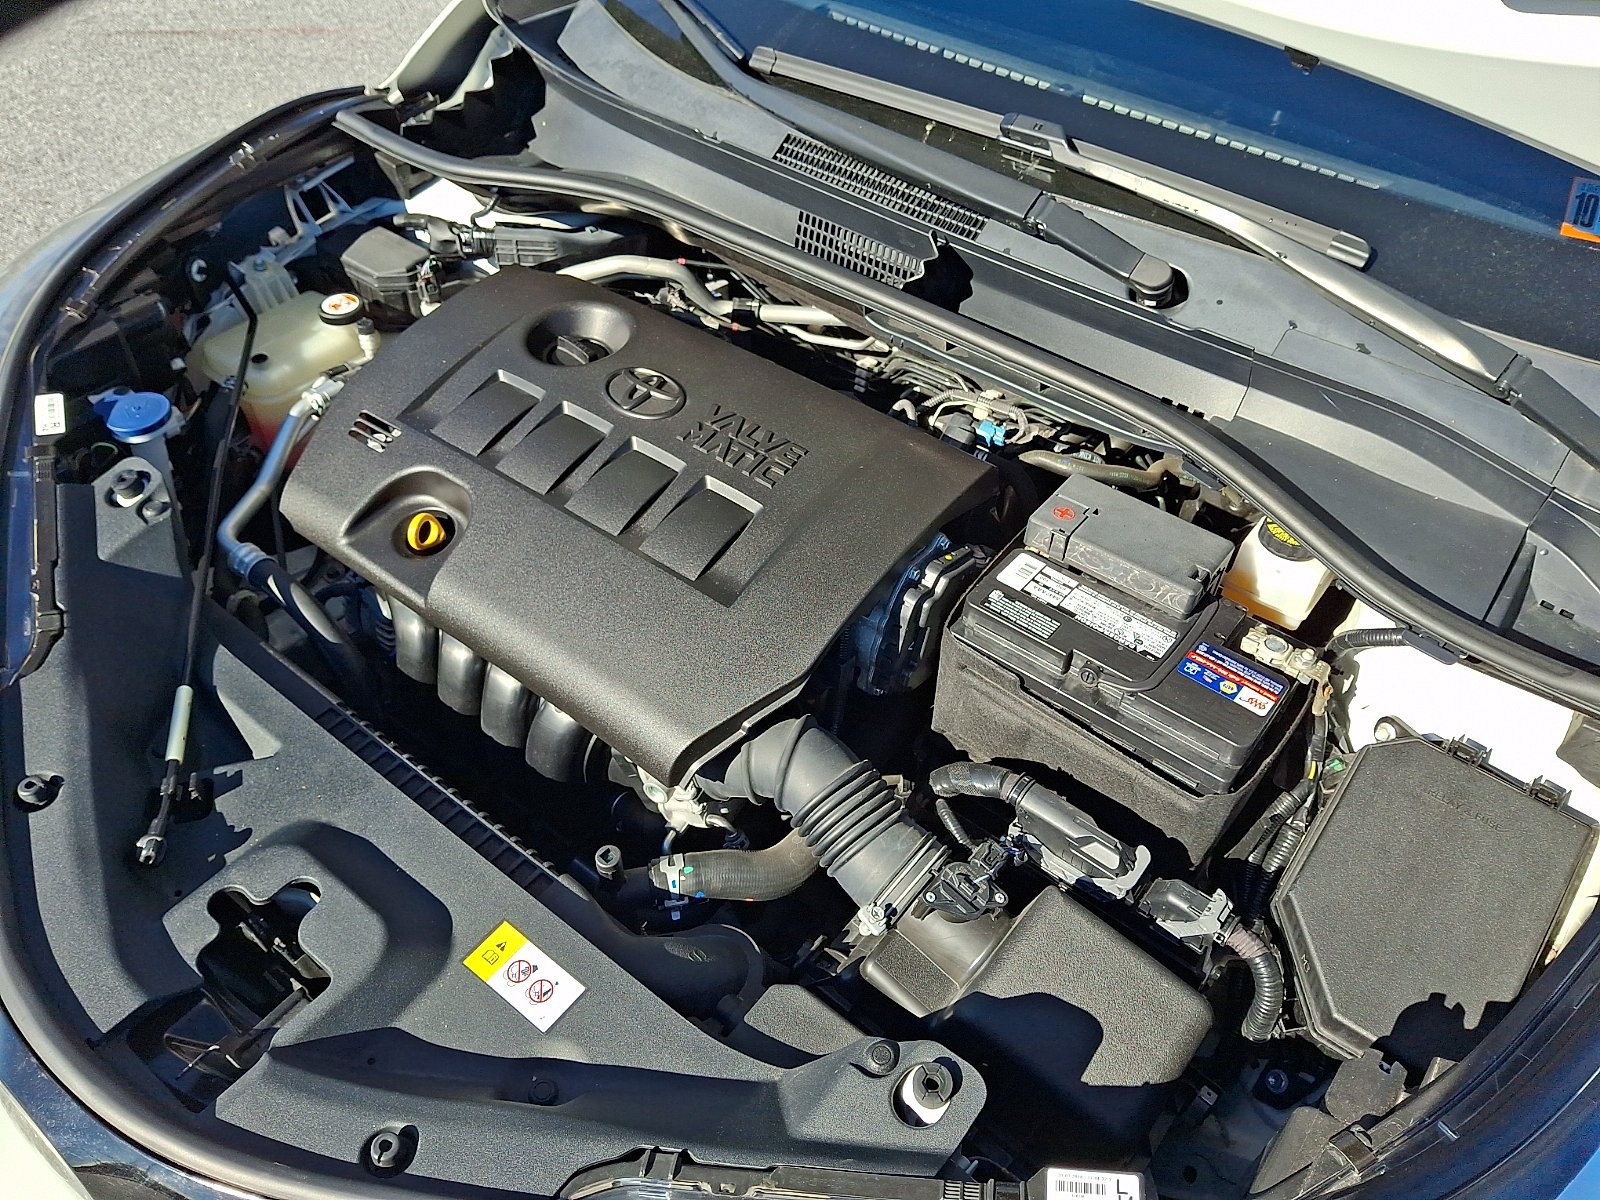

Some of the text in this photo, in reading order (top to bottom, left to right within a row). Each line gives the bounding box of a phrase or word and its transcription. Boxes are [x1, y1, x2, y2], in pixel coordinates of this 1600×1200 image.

[1573, 192, 1600, 228] 10
[676, 421, 778, 489] MATIC
[705, 403, 809, 475] VALVE
[1427, 788, 1464, 810] RELAY
[1475, 812, 1504, 832] FUSE
